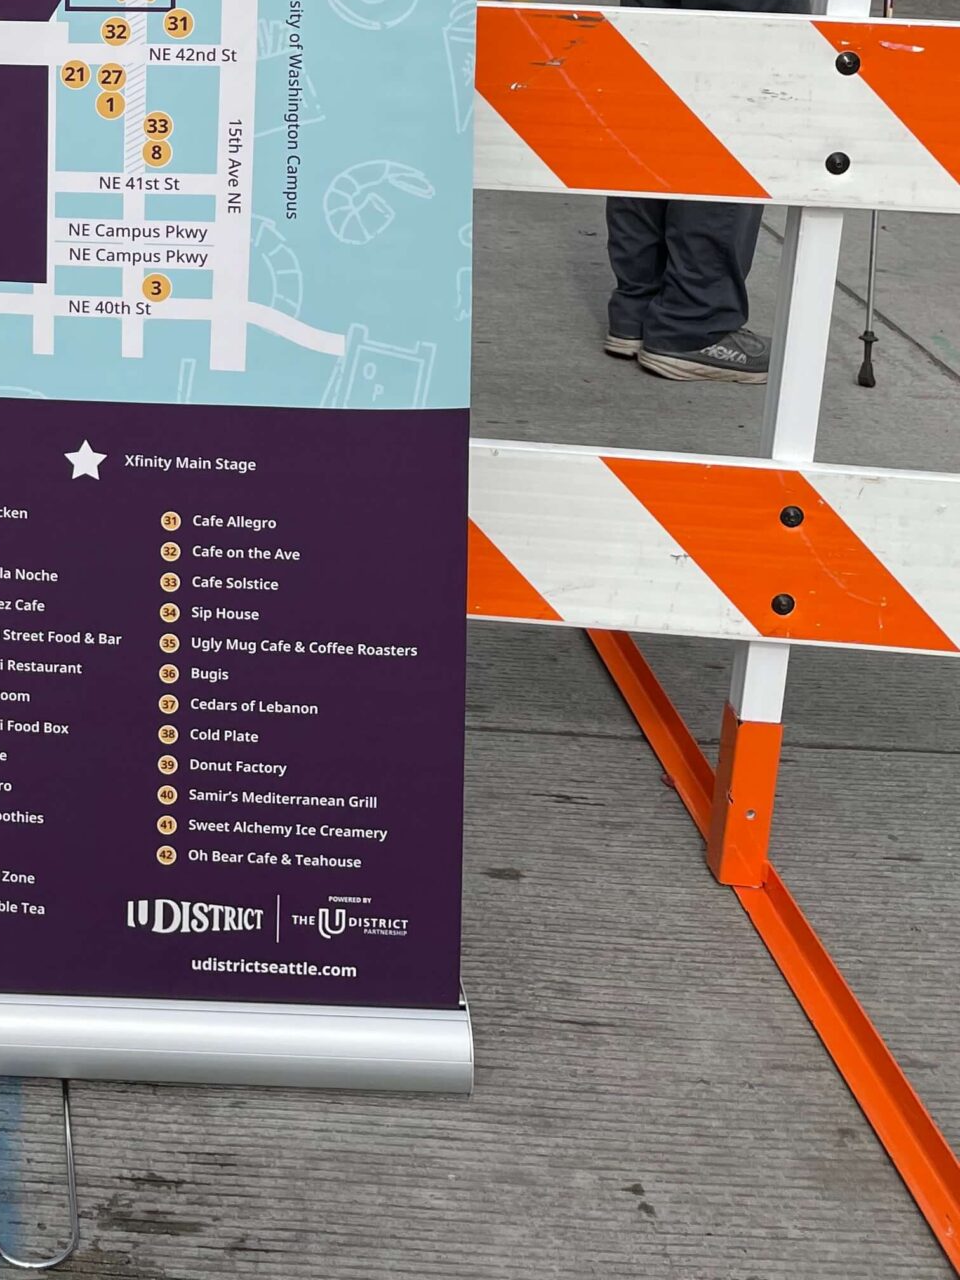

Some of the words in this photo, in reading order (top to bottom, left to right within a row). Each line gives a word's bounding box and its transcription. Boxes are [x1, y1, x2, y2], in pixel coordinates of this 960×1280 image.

[289, 33, 304, 51] of
[149, 47, 171, 61] NE
[175, 47, 216, 62] 42nd
[221, 48, 237, 63] St
[283, 53, 303, 150] Washington
[228, 119, 243, 154] 15th
[227, 158, 242, 188] Ave
[99, 176, 121, 190] NE
[125, 176, 160, 191] 41st
[164, 177, 180, 191] St
[282, 155, 301, 220] Campus
[227, 192, 242, 214] NE
[68, 223, 90, 237] NE
[95, 223, 161, 242] Campus
[165, 224, 208, 243] Pkwy
[69, 247, 91, 261] NE
[95, 248, 161, 266] Campus
[166, 249, 208, 268] Pkwy
[69, 300, 90, 314] NE
[94, 301, 131, 315] 40th
[135, 301, 151, 316] St
[124, 454, 173, 472] Xfinity
[175, 456, 212, 470] Main
[215, 457, 257, 474] Stage
[191, 637, 223, 653] Ugly
[226, 638, 257, 654] Mug
[260, 639, 292, 653] Cafe
[294, 641, 306, 653] &
[309, 641, 354, 655] Coffee
[357, 643, 418, 657] Roasters
[7, 659, 83, 674] Restaurant
[188, 788, 239, 803] Samir's
[242, 791, 345, 807] Mediterranean
[348, 796, 377, 809] Grill
[327, 895, 362, 904] POWERED
[291, 914, 316, 926] THE
[348, 917, 409, 930] DISTRICT
[191, 957, 357, 978] udistrictseattle.com
